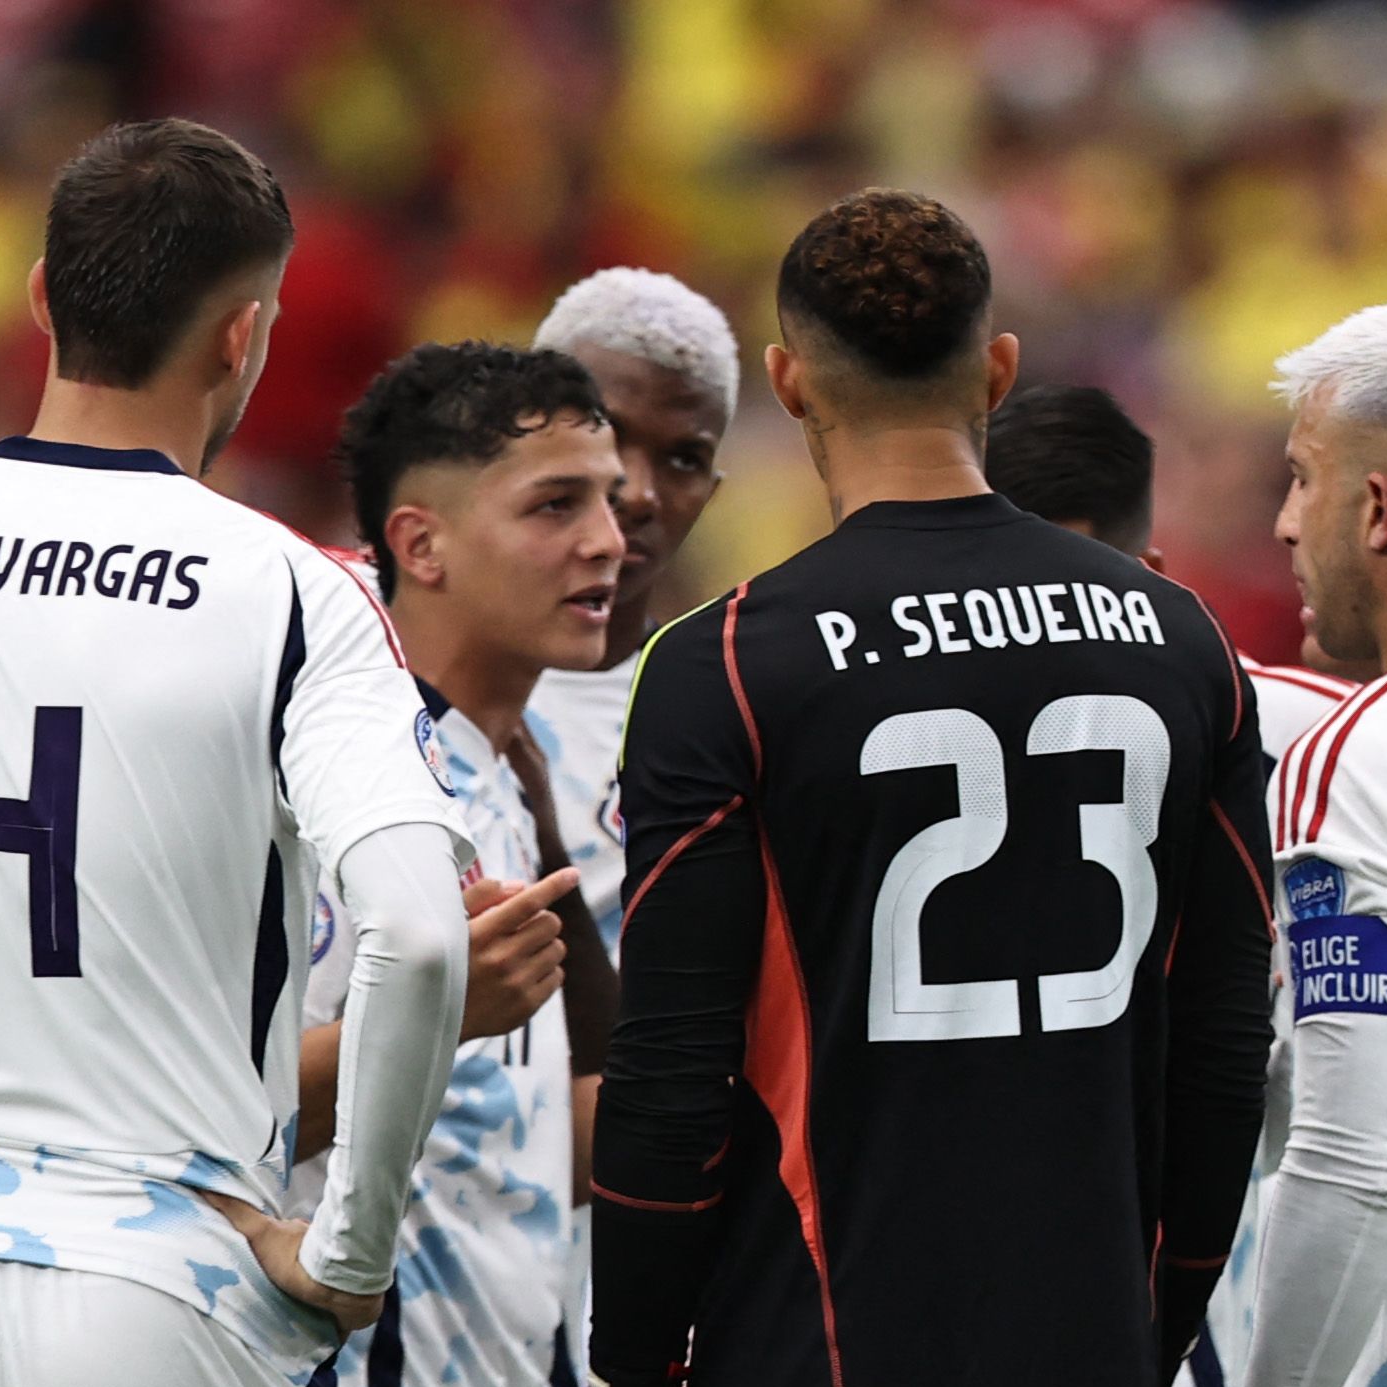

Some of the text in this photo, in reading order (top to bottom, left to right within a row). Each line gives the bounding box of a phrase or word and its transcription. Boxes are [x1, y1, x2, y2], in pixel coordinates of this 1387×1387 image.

[815, 582, 1165, 671] P. SEQUEIRA
[860, 695, 1171, 1042] 23
[1291, 875, 1336, 904] VIBRA
[1302, 936, 1361, 971] ELIGE
